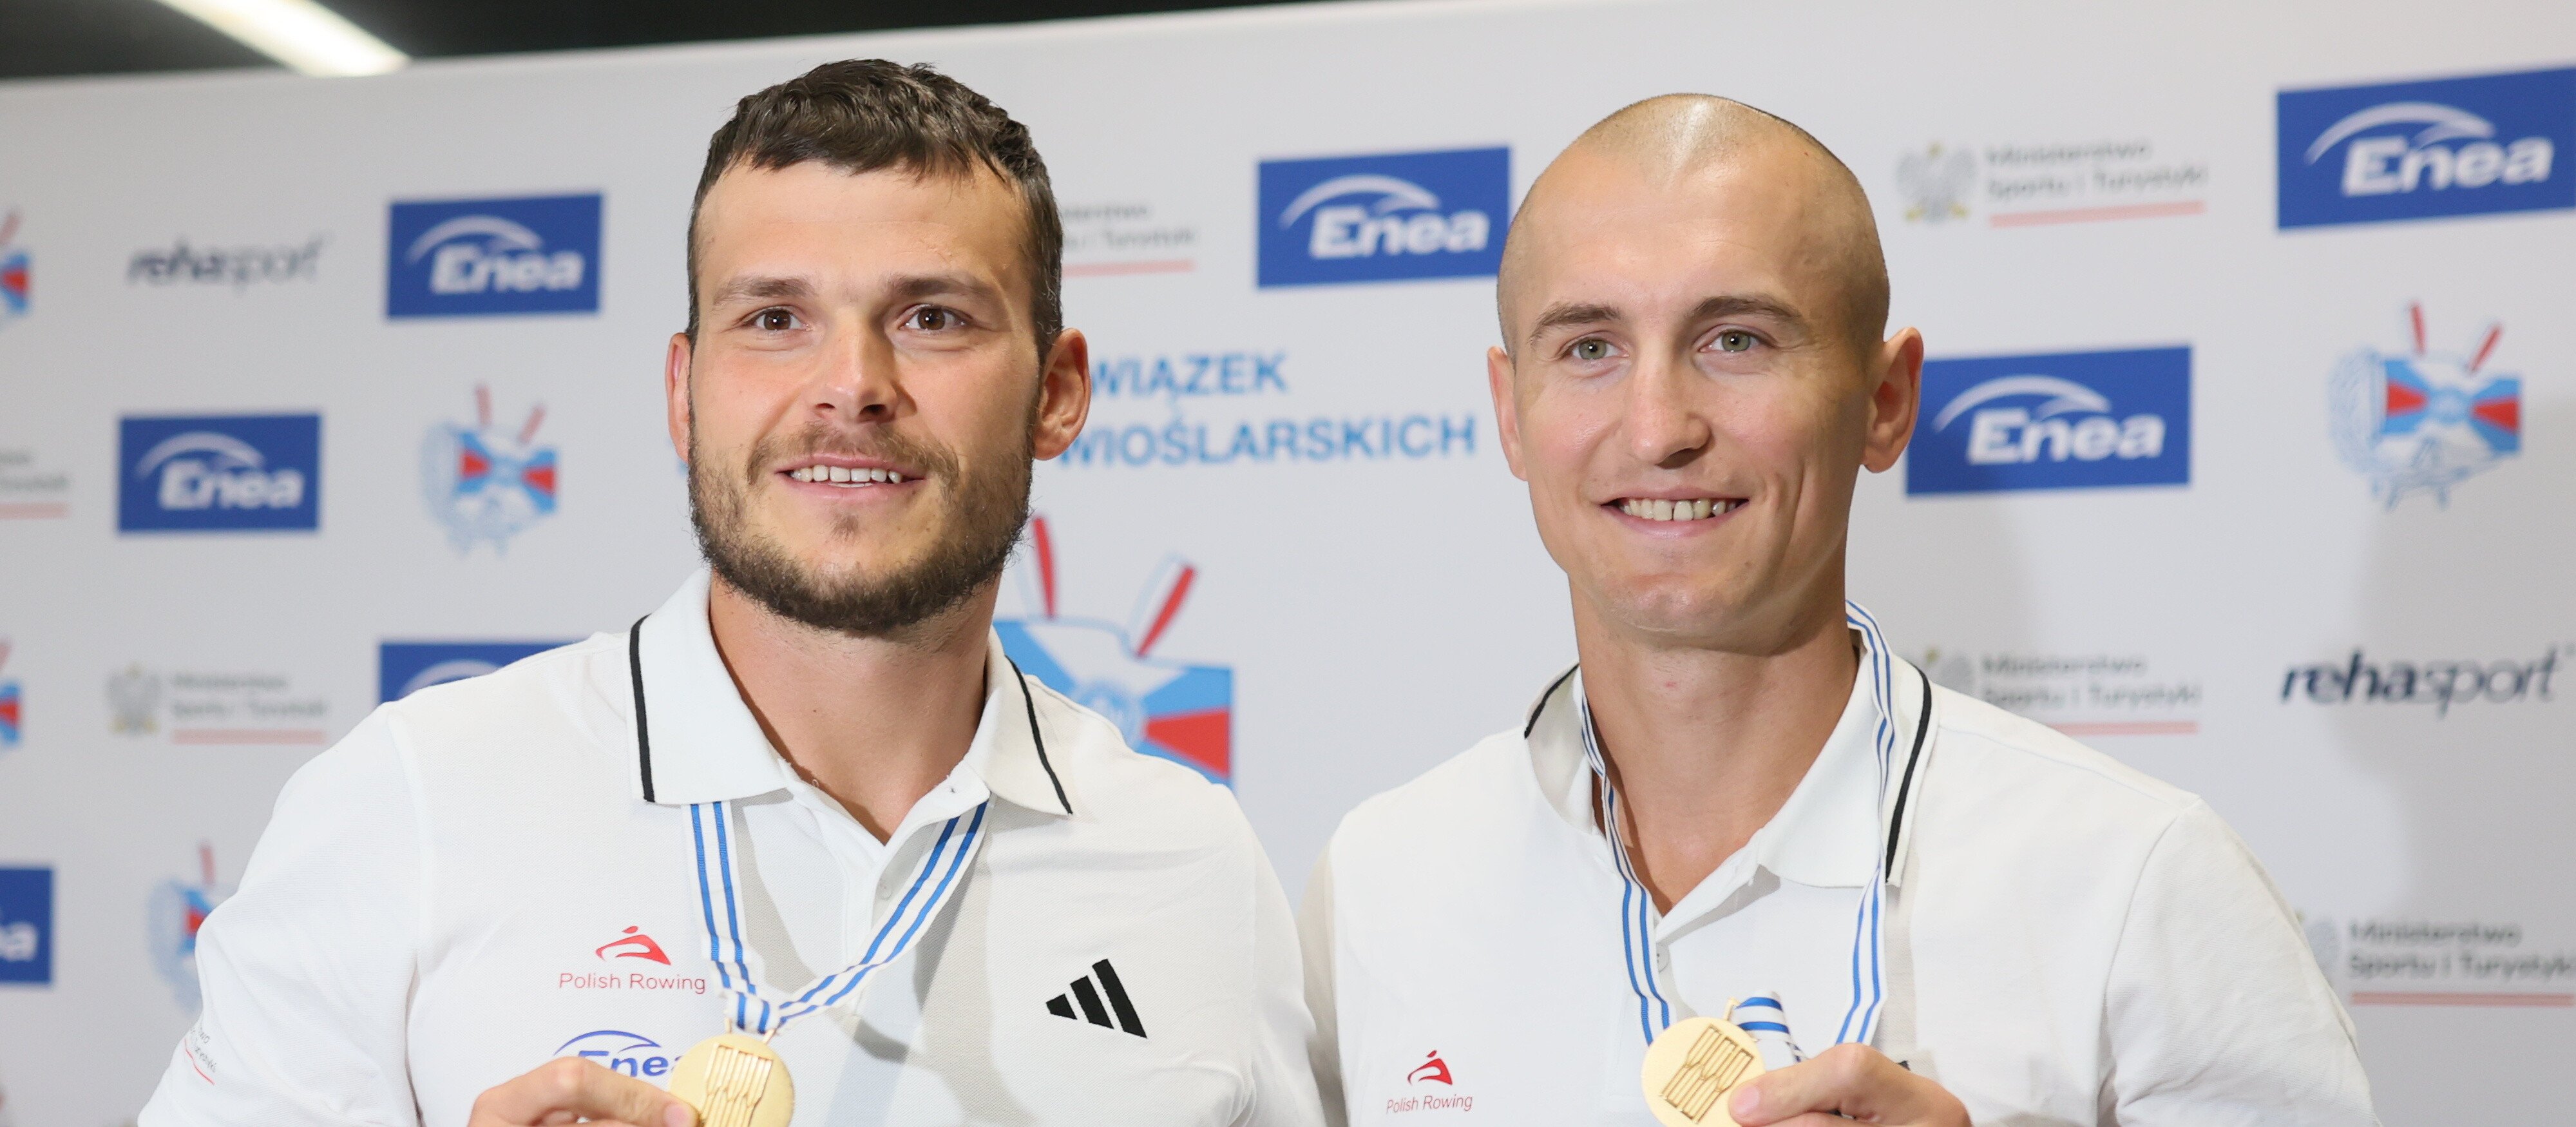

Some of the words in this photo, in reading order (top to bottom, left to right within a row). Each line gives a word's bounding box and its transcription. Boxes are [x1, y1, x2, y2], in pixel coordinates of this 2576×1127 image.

[2342, 134, 2554, 197] Enea
[1308, 204, 1491, 259] Enea
[430, 244, 586, 294] Enea
[1091, 351, 1288, 409] WIĄZEK
[1967, 407, 2166, 465] Enea
[158, 460, 305, 510] Enea
[2279, 646, 2557, 720] rehasport
[558, 972, 622, 990] Polish
[629, 972, 706, 995] Rowing
[578, 1050, 683, 1078] ne
[1386, 1096, 1419, 1115] Polish
[1422, 1093, 1473, 1112] Rowing
